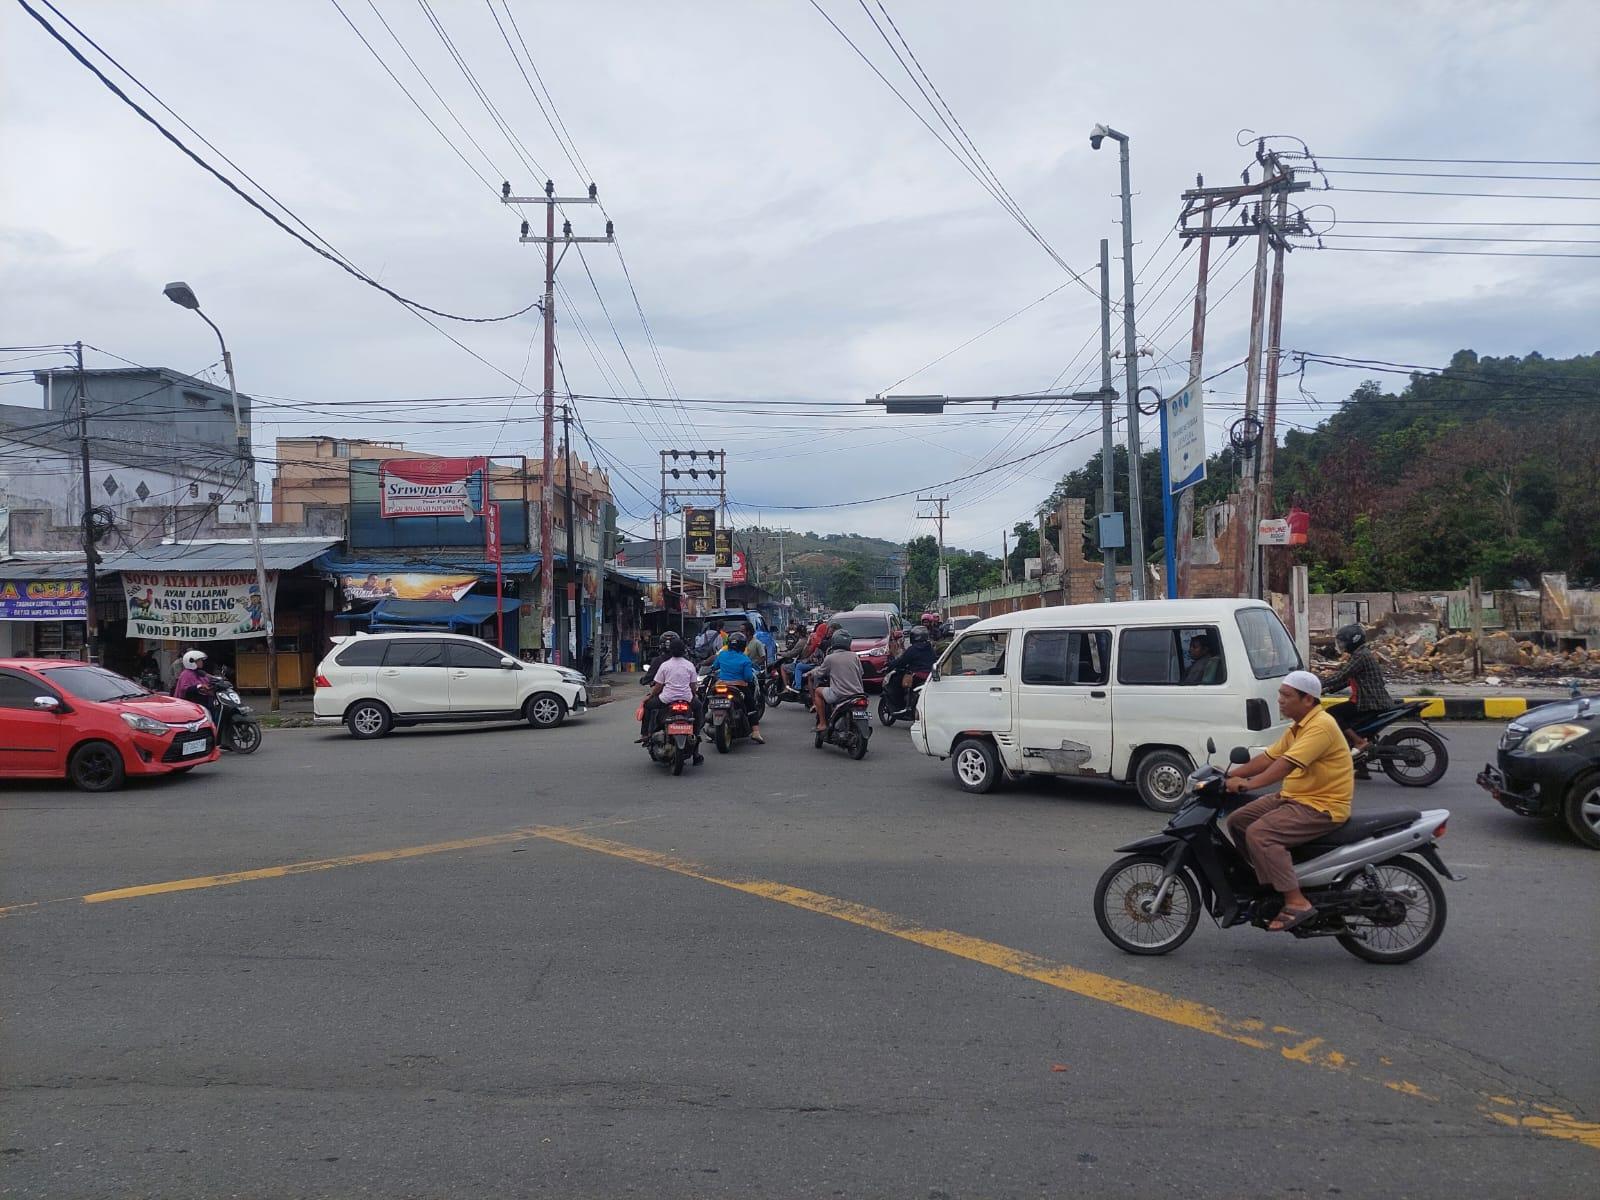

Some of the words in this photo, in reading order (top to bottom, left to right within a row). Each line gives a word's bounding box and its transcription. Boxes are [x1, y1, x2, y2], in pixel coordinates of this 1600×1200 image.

[388, 484, 453, 497] Sriwijaya
[126, 574, 160, 587] SOTO
[163, 574, 199, 588] AYAM
[26, 581, 87, 600] CELL
[164, 589, 186, 598] AYAM
[191, 589, 228, 598] LALAPAN
[154, 598, 182, 611] NASI
[185, 598, 235, 611] GORENG
[136, 623, 170, 636] Wong
[172, 625, 218, 638] Pilang
